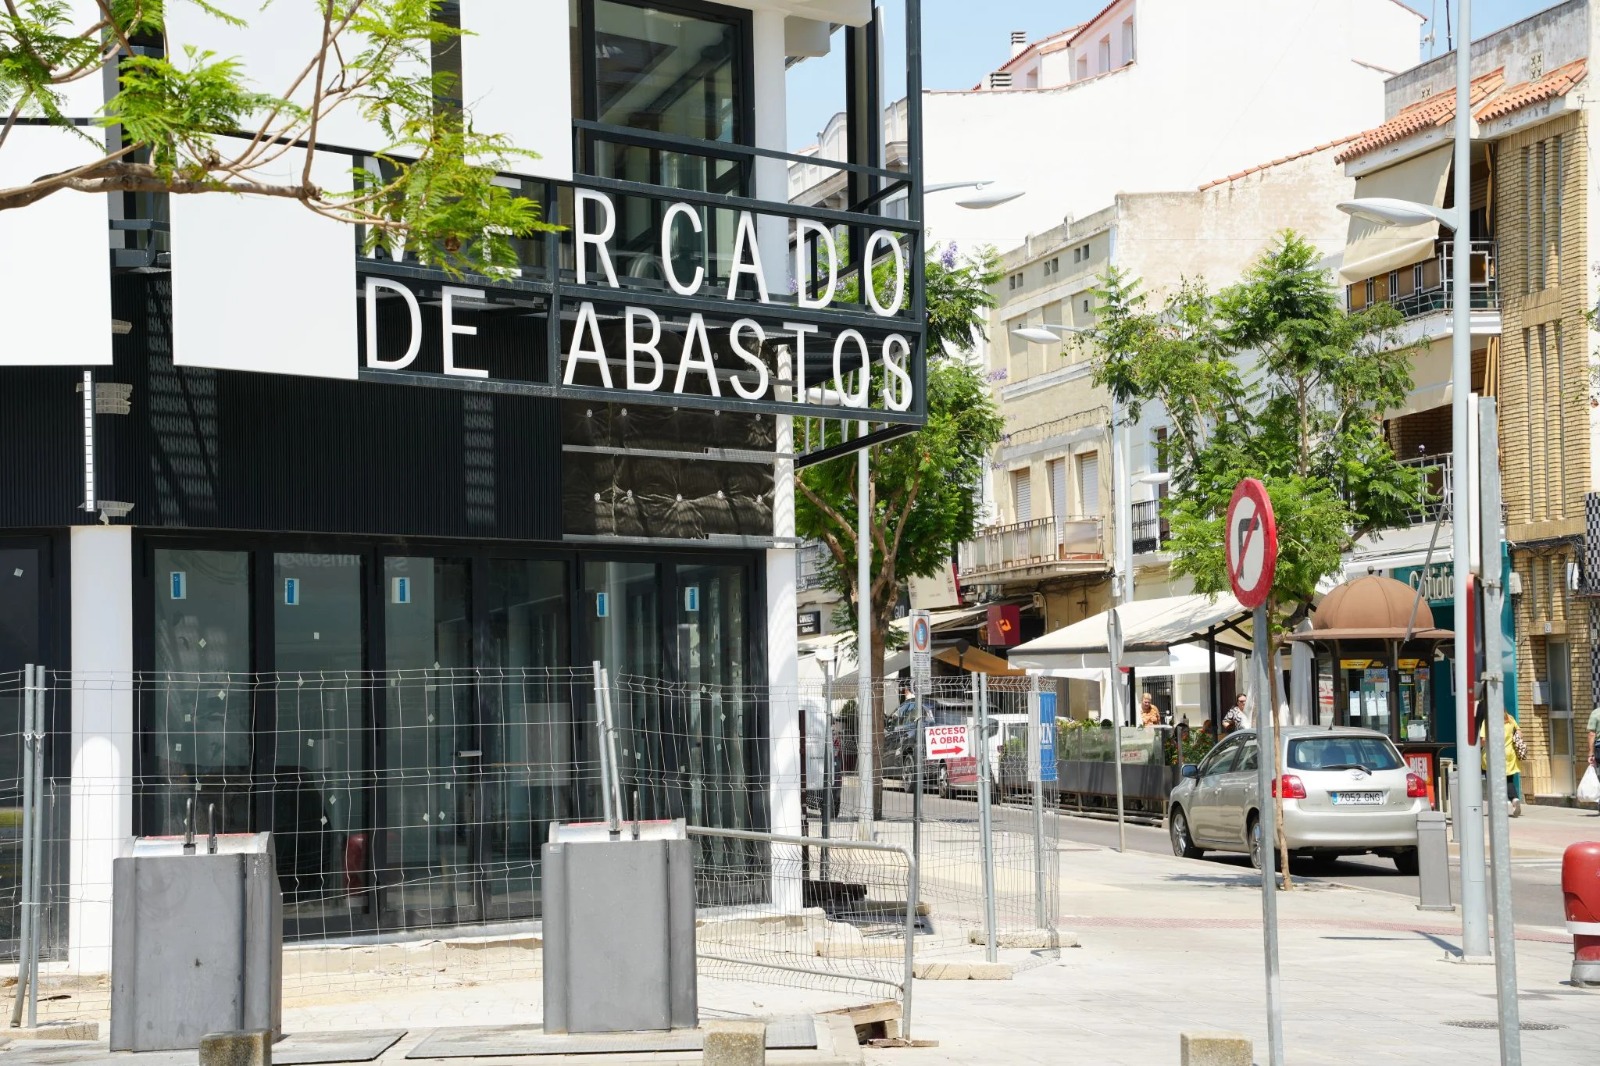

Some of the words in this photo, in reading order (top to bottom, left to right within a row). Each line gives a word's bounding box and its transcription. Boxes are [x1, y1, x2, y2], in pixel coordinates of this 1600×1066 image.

[365, 276, 490, 379] DE
[562, 301, 914, 413] ABASTOS
[929, 726, 966, 736] ACCESO
[930, 737, 937, 745] A
[939, 735, 966, 745] OBRA
[1338, 792, 1362, 802] 7052
